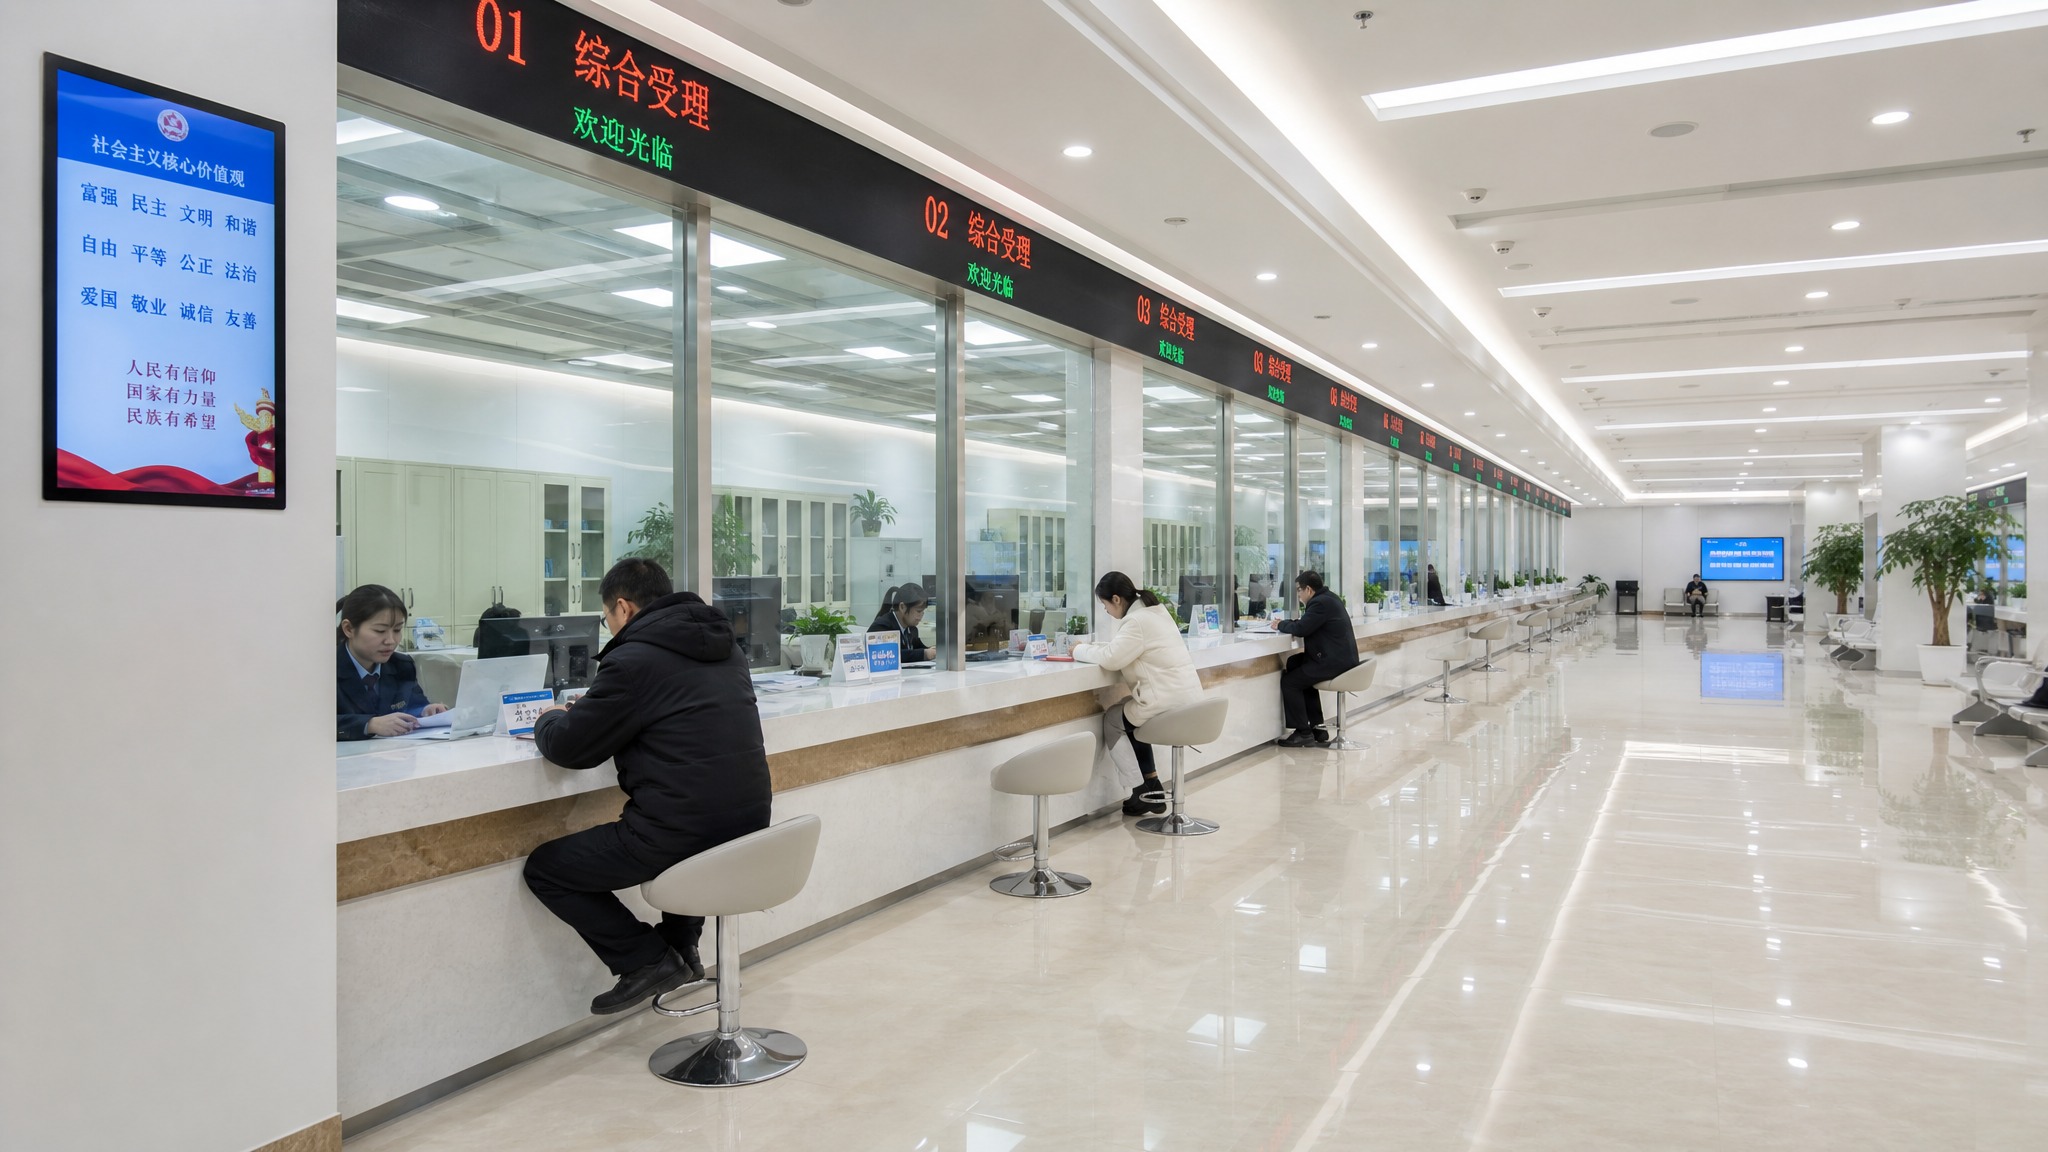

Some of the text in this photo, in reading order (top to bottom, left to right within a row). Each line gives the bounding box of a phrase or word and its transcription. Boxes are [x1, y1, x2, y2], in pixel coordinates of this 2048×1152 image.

[475, 0, 711, 131] 01 综合受理
[91, 134, 246, 188] 社会主义核心价值观
[572, 106, 674, 171] 欢迎光临
[80, 182, 257, 236] 富强 民主 文明 和谐
[924, 195, 1032, 270] 02 综合受理
[82, 234, 257, 284] 自由 平等 公正 法治
[966, 262, 1014, 299] 欢迎光临
[80, 286, 257, 330] 爱国 敬业 诚信 友善
[1137, 295, 1195, 341] 03 综合受理
[126, 359, 216, 385] 人民有信仰
[127, 382, 216, 408] 国家有力量
[127, 407, 217, 431] 民族有希望
